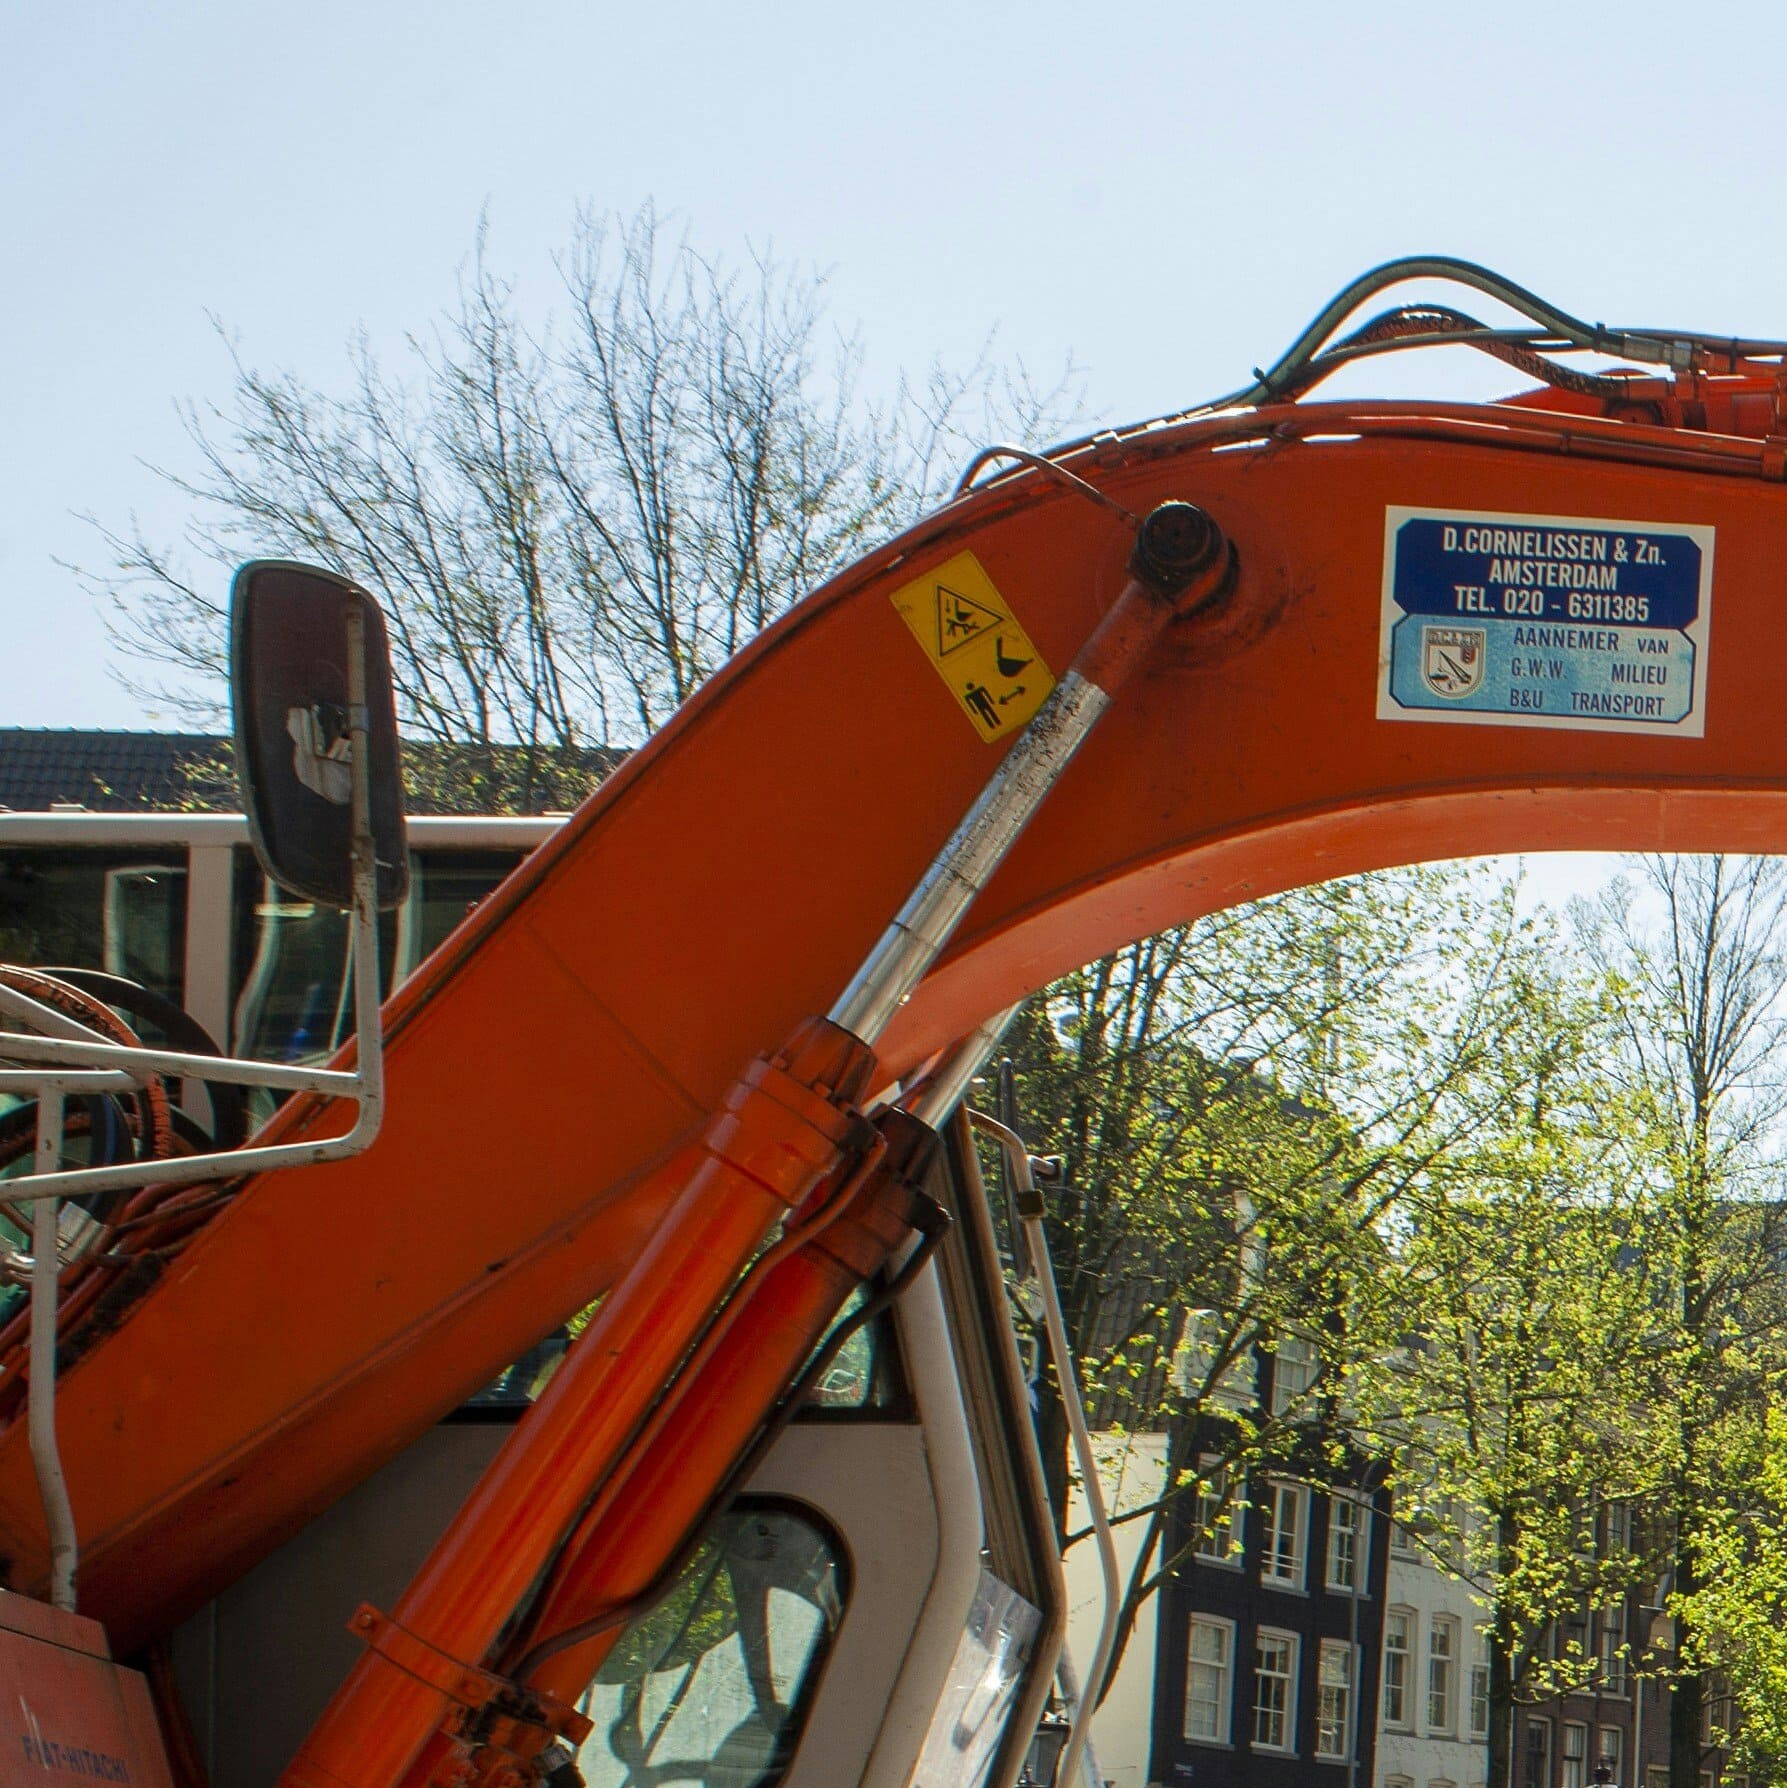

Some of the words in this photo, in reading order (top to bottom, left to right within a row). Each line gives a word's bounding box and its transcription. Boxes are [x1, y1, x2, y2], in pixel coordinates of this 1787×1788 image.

[1442, 526, 1607, 561] D.CORNELISSEN
[1614, 537, 1629, 563] &
[1635, 539, 1667, 566] Zn.
[1488, 559, 1618, 591] AMSTERDAM
[1454, 585, 1496, 613] TEL.
[1504, 588, 1544, 616] 020
[1568, 592, 1650, 622] 6311385
[1513, 626, 1620, 651] AANNEMER
[1638, 637, 1670, 655] VAN
[1511, 656, 1568, 680] G.W.W.
[1611, 662, 1668, 686] MILIEU
[1510, 687, 1544, 710] B&U
[1571, 691, 1666, 717] TRANSPORT
